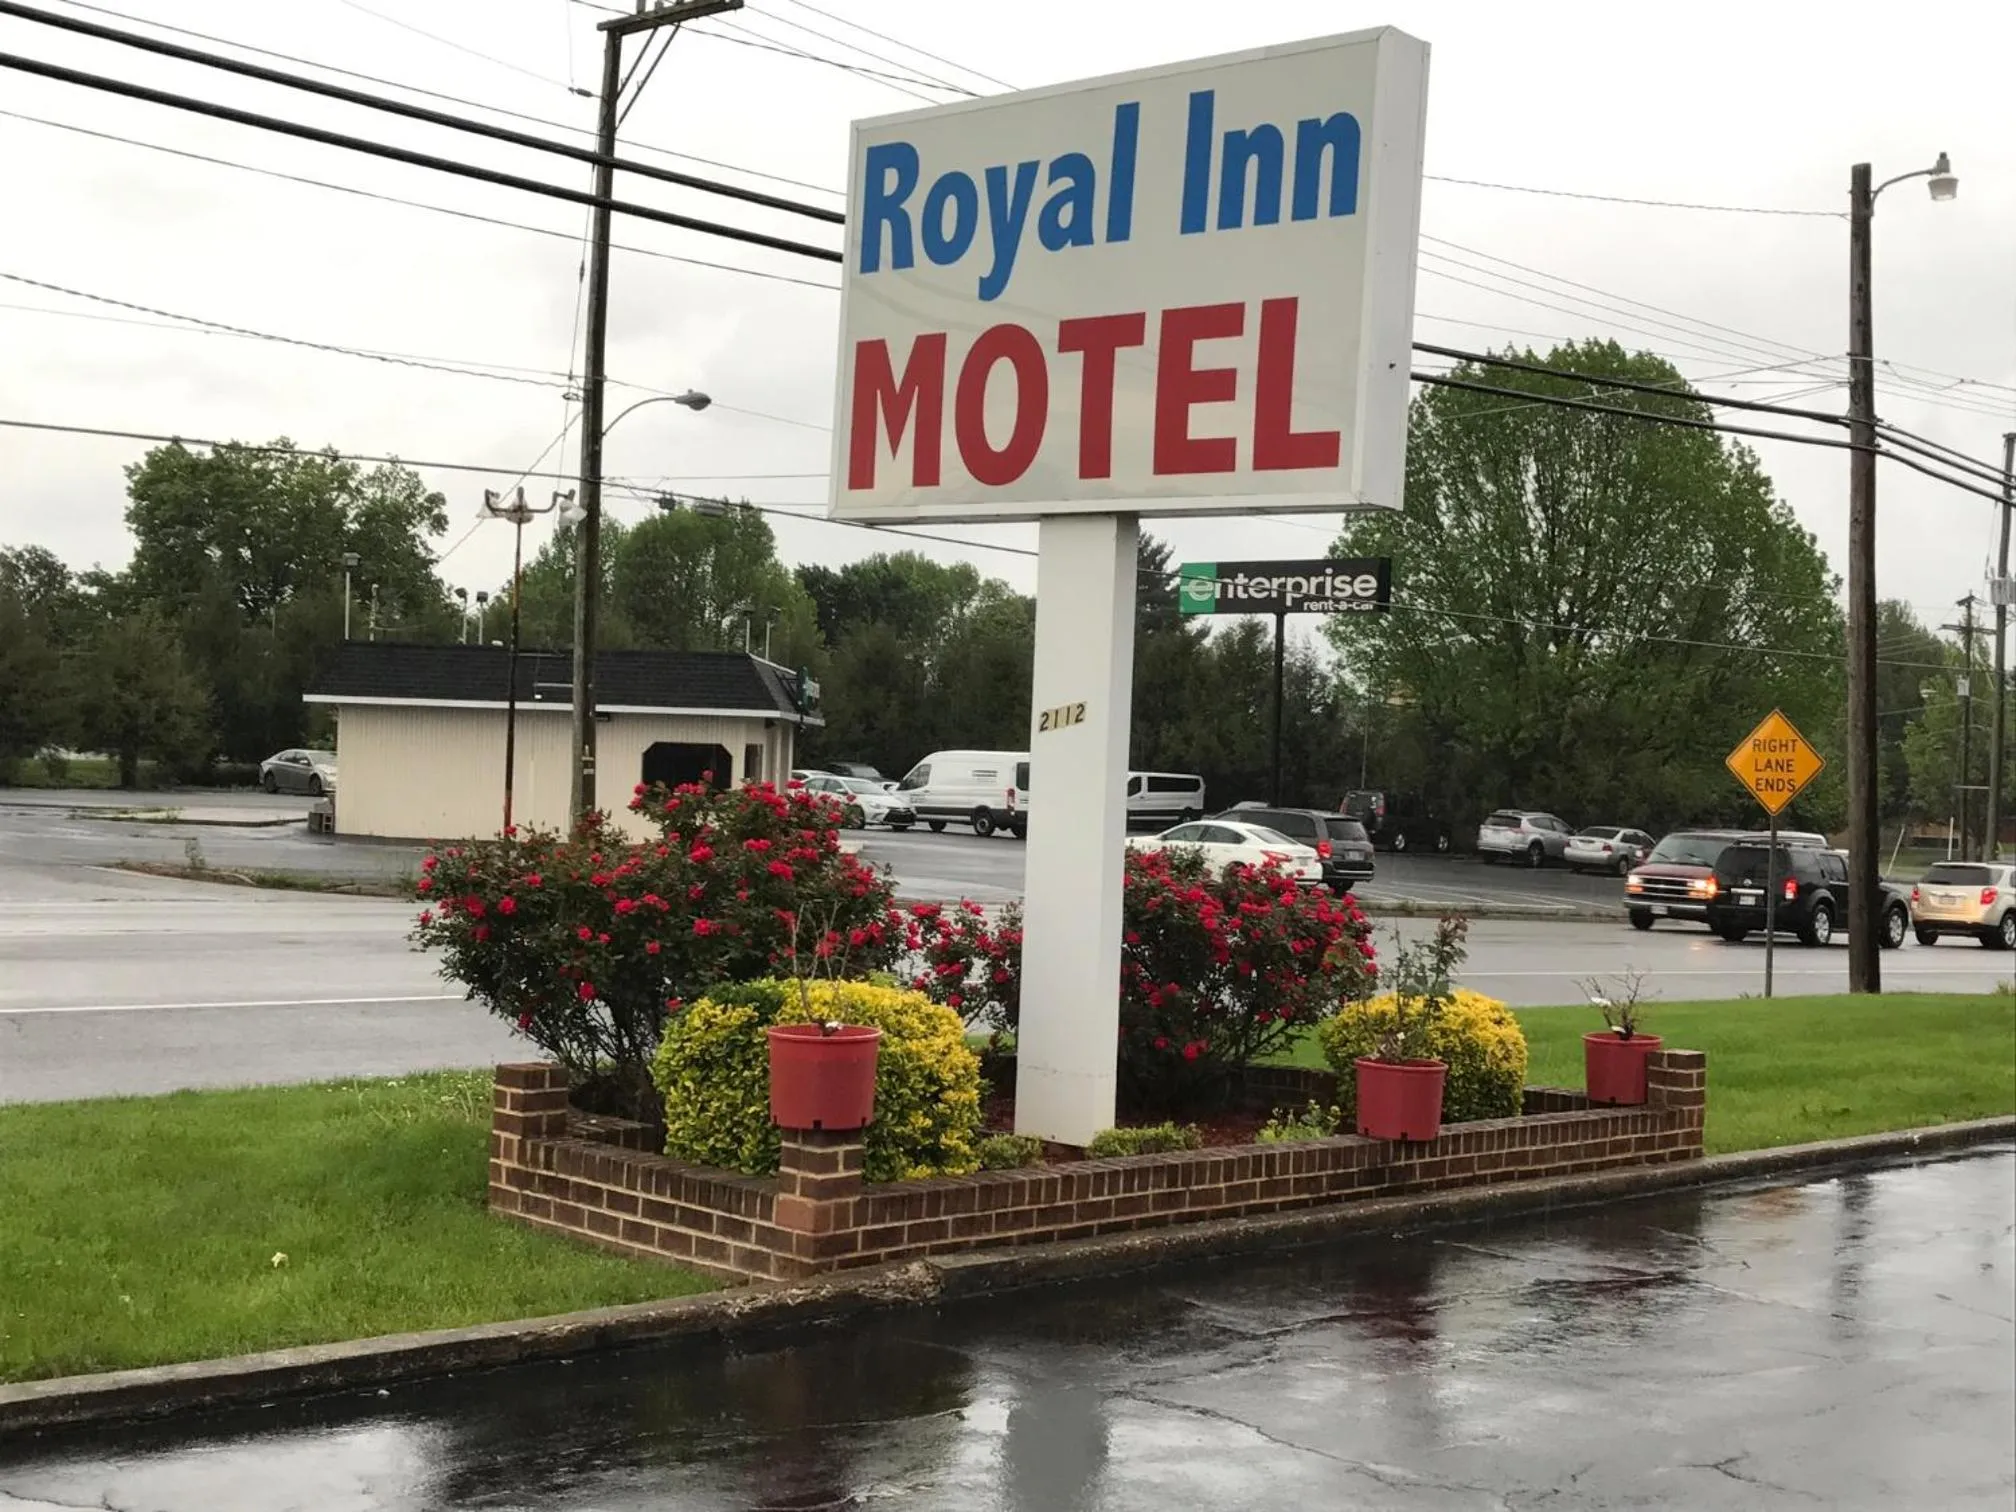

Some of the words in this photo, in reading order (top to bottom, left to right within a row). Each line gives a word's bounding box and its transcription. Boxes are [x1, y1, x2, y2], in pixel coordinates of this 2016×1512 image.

[859, 102, 1140, 302] Royal
[1180, 90, 1361, 235] Inn
[848, 296, 1341, 490] MOTEL
[1186, 567, 1377, 607] enterprise
[1303, 599, 1375, 612] rent-a-car
[1039, 703, 1085, 733] 2112
[1752, 738, 1797, 753] RIGHT
[1754, 758, 1795, 772] LANE
[1755, 778, 1796, 792] ENDS
